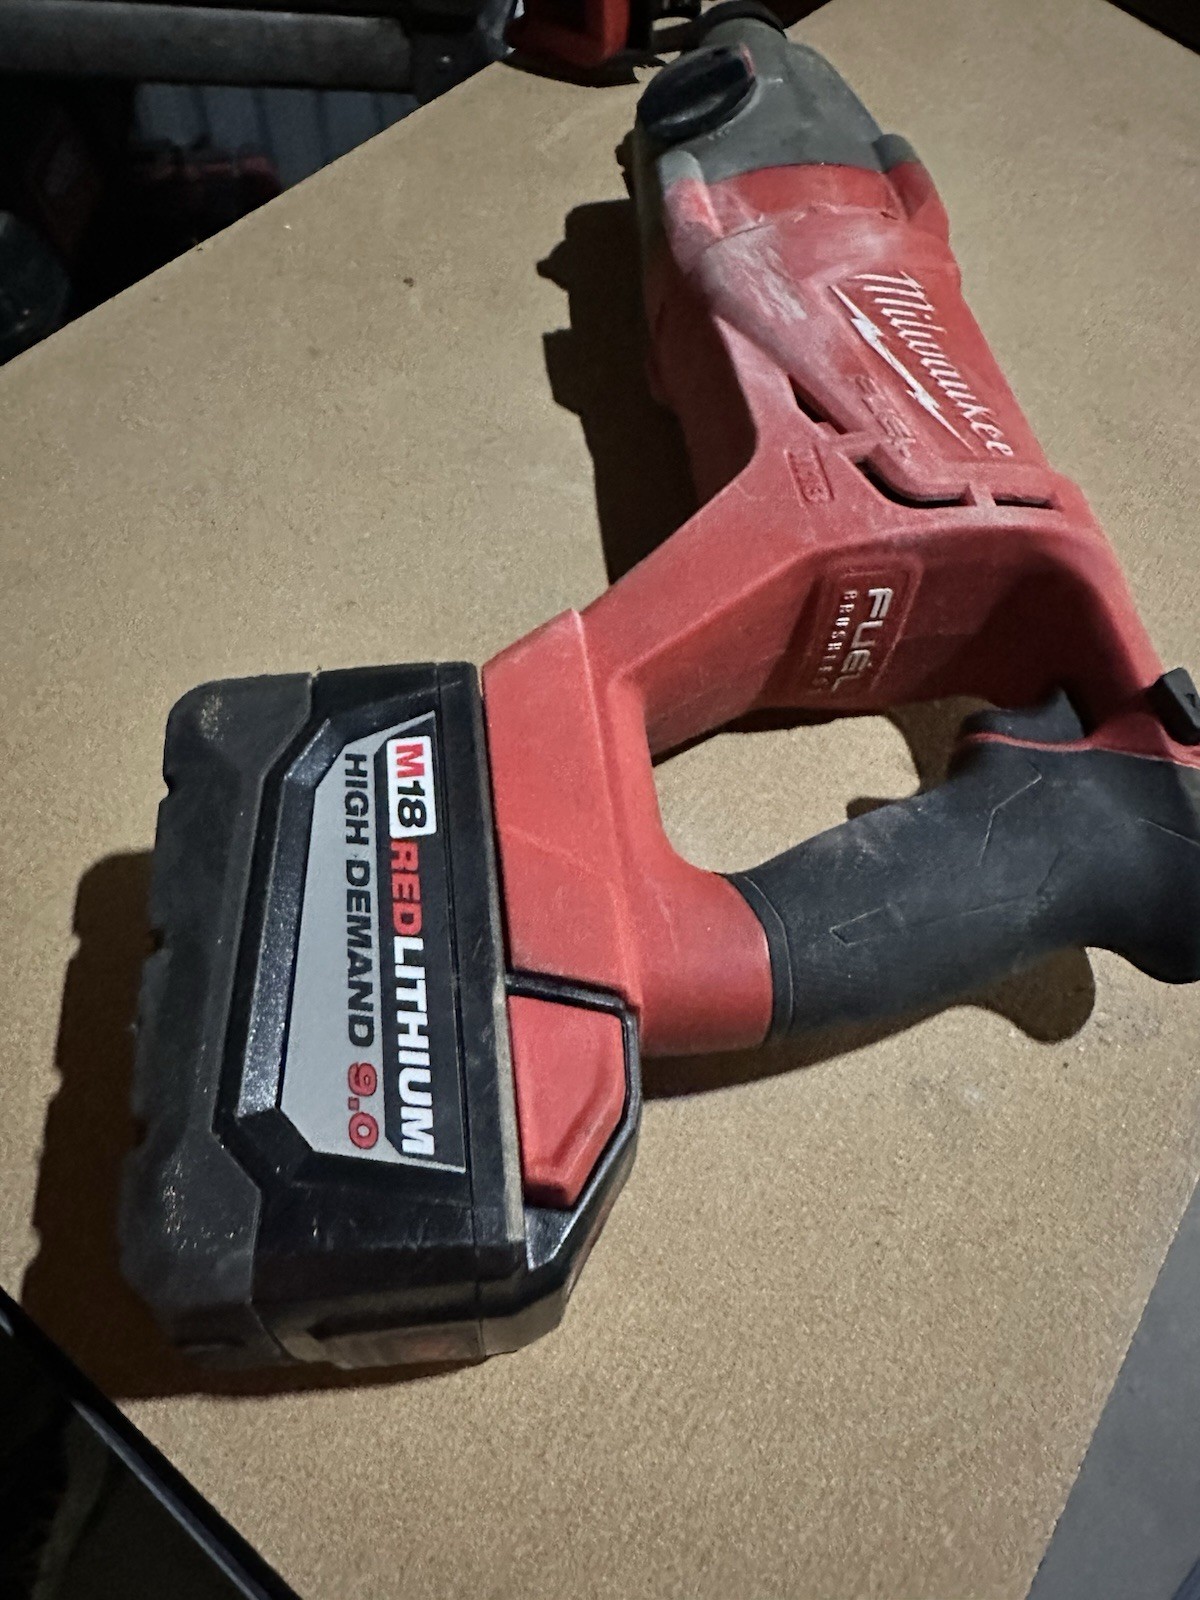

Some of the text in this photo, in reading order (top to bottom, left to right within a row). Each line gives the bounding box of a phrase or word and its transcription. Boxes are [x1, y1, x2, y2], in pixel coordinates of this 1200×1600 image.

[849, 271, 1014, 457] Milwaukee
[832, 588, 894, 693] FUEL
[395, 743, 428, 828] M18
[344, 753, 380, 1149] HIGH DEMAND 9.0
